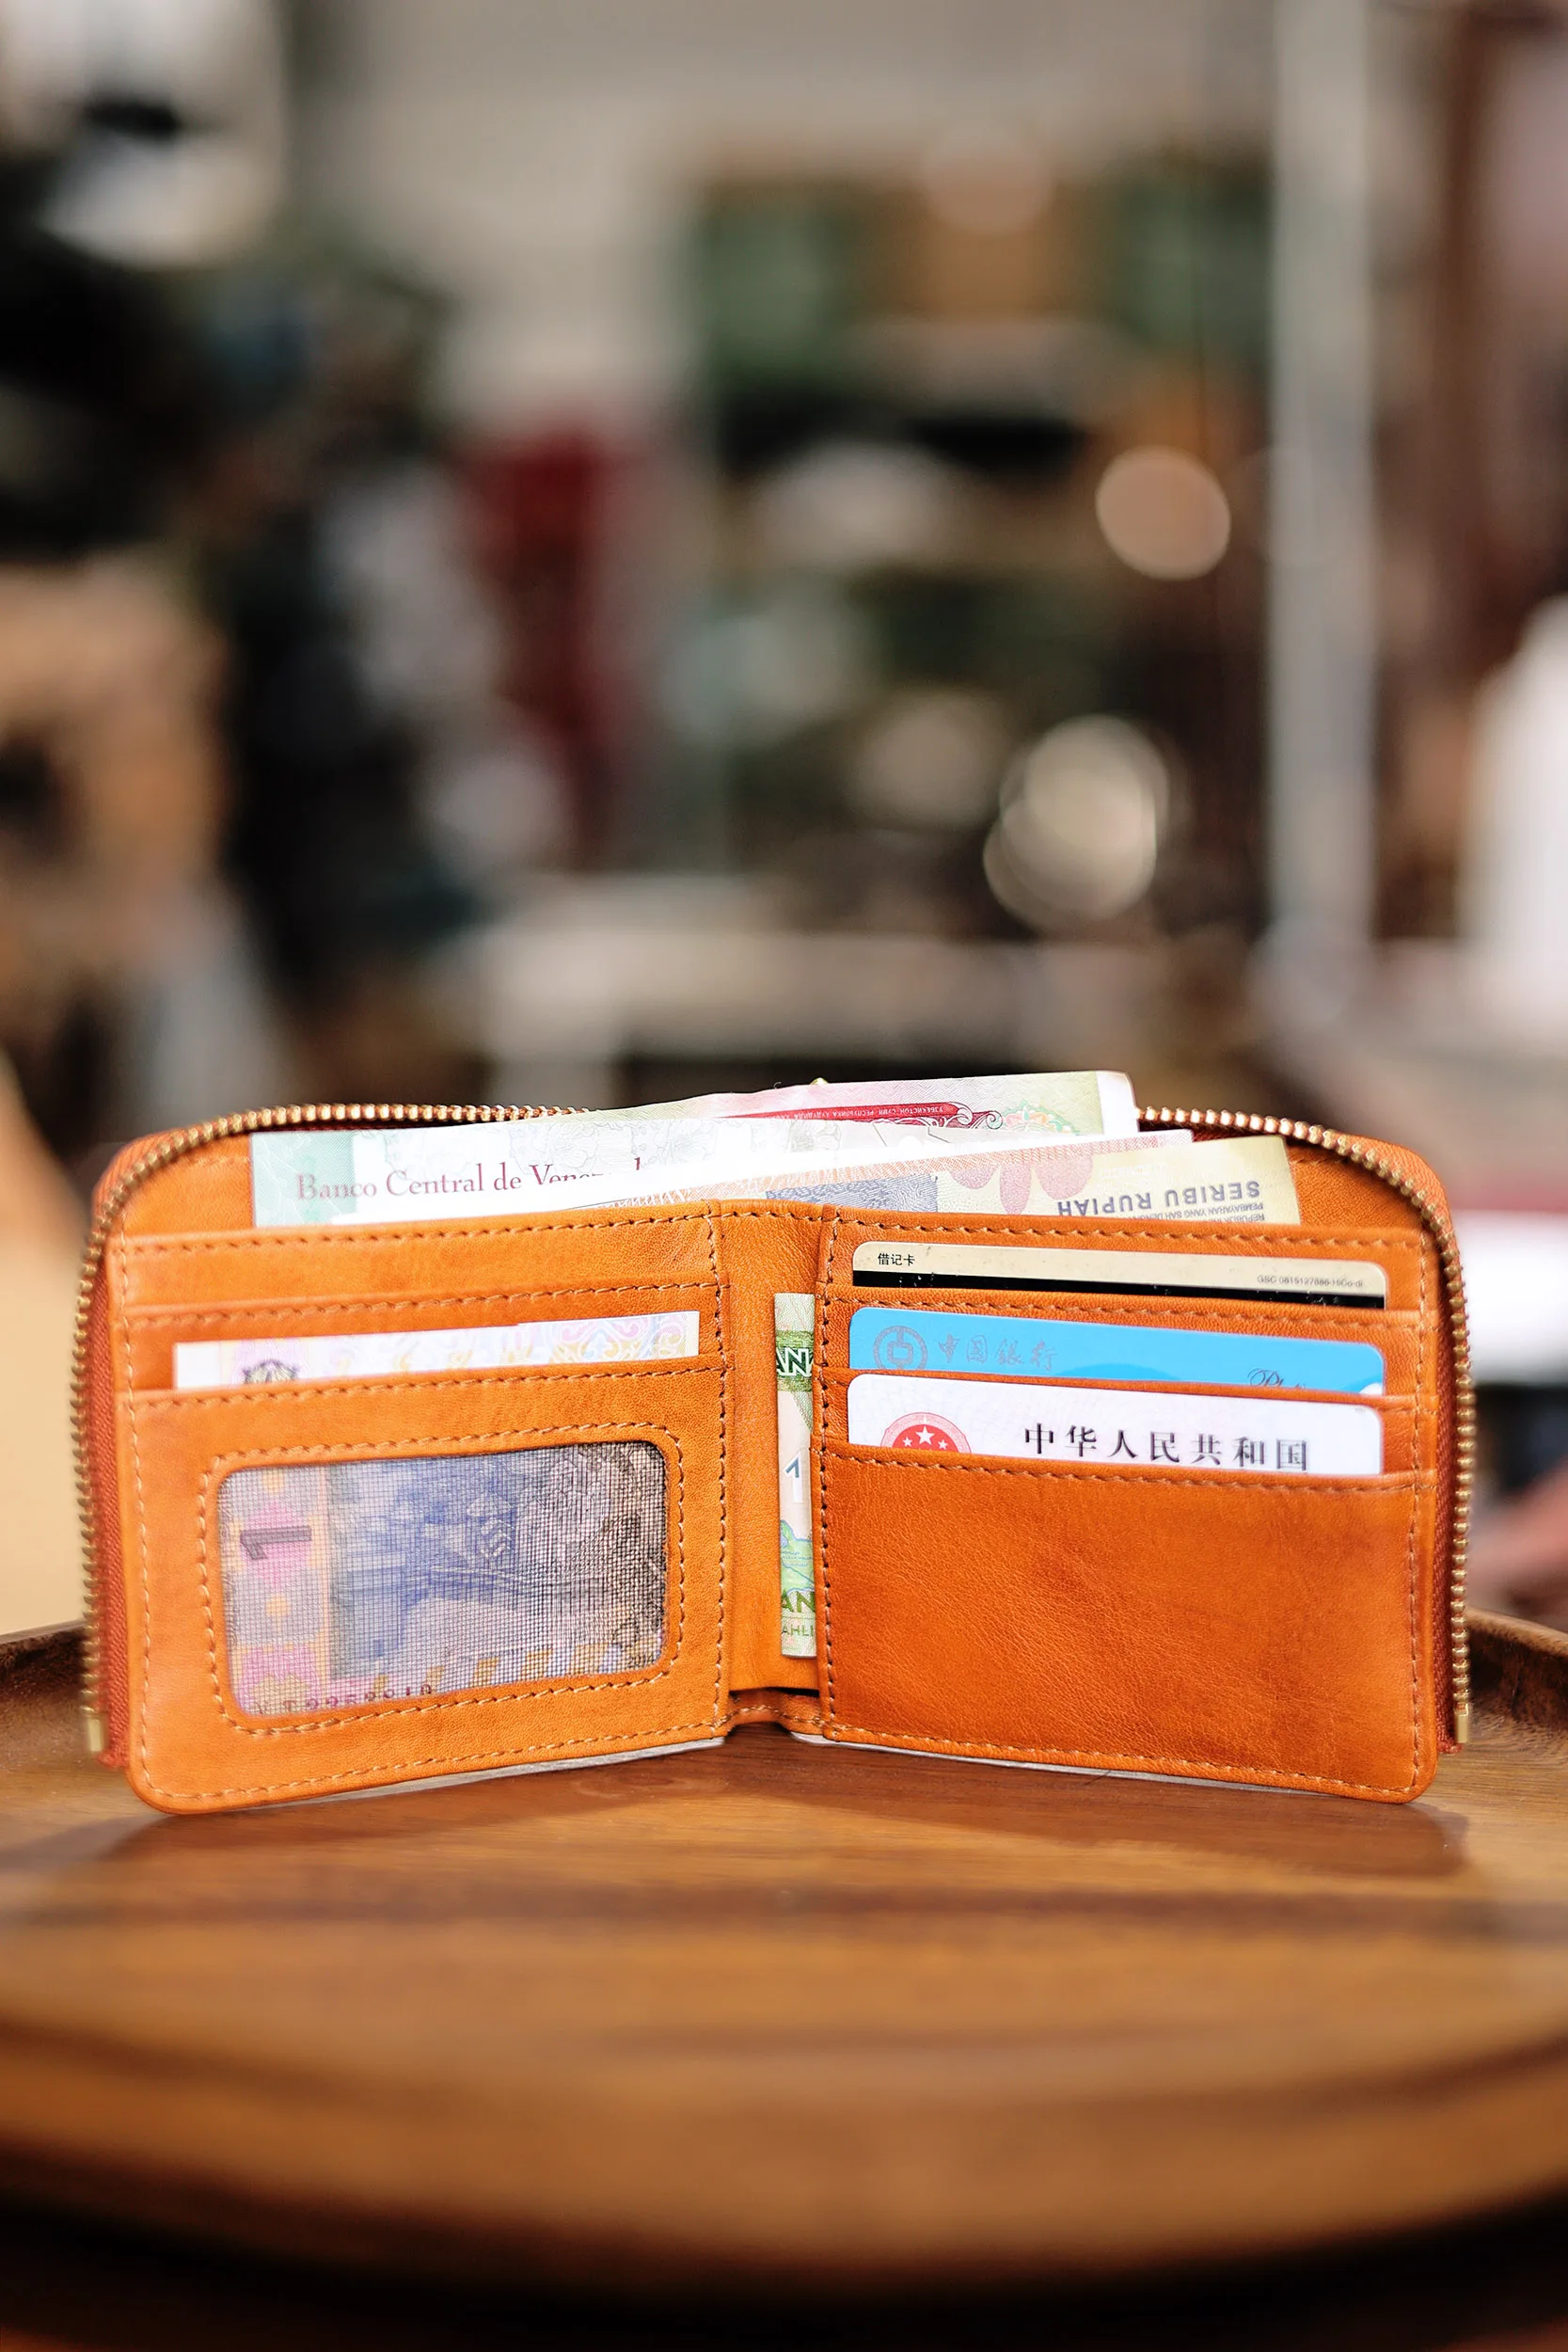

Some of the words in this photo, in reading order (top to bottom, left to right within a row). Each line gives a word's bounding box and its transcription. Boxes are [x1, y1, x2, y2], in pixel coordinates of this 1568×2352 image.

[295, 1172, 377, 1200] Banco
[386, 1161, 483, 1196] Central
[494, 1161, 522, 1191] de
[1056, 1192, 1151, 1217] RUPIAH
[1164, 1181, 1260, 1208] SERIBU
[1165, 1211, 1182, 1220] SAH
[1183, 1209, 1206, 1218] YANG
[1207, 1202, 1264, 1216] PEMBAYARAN
[878, 1252, 915, 1266] 借记卡
[1024, 1422, 1307, 1471] 中华人民共和国
[784, 1450, 803, 1504] 1
